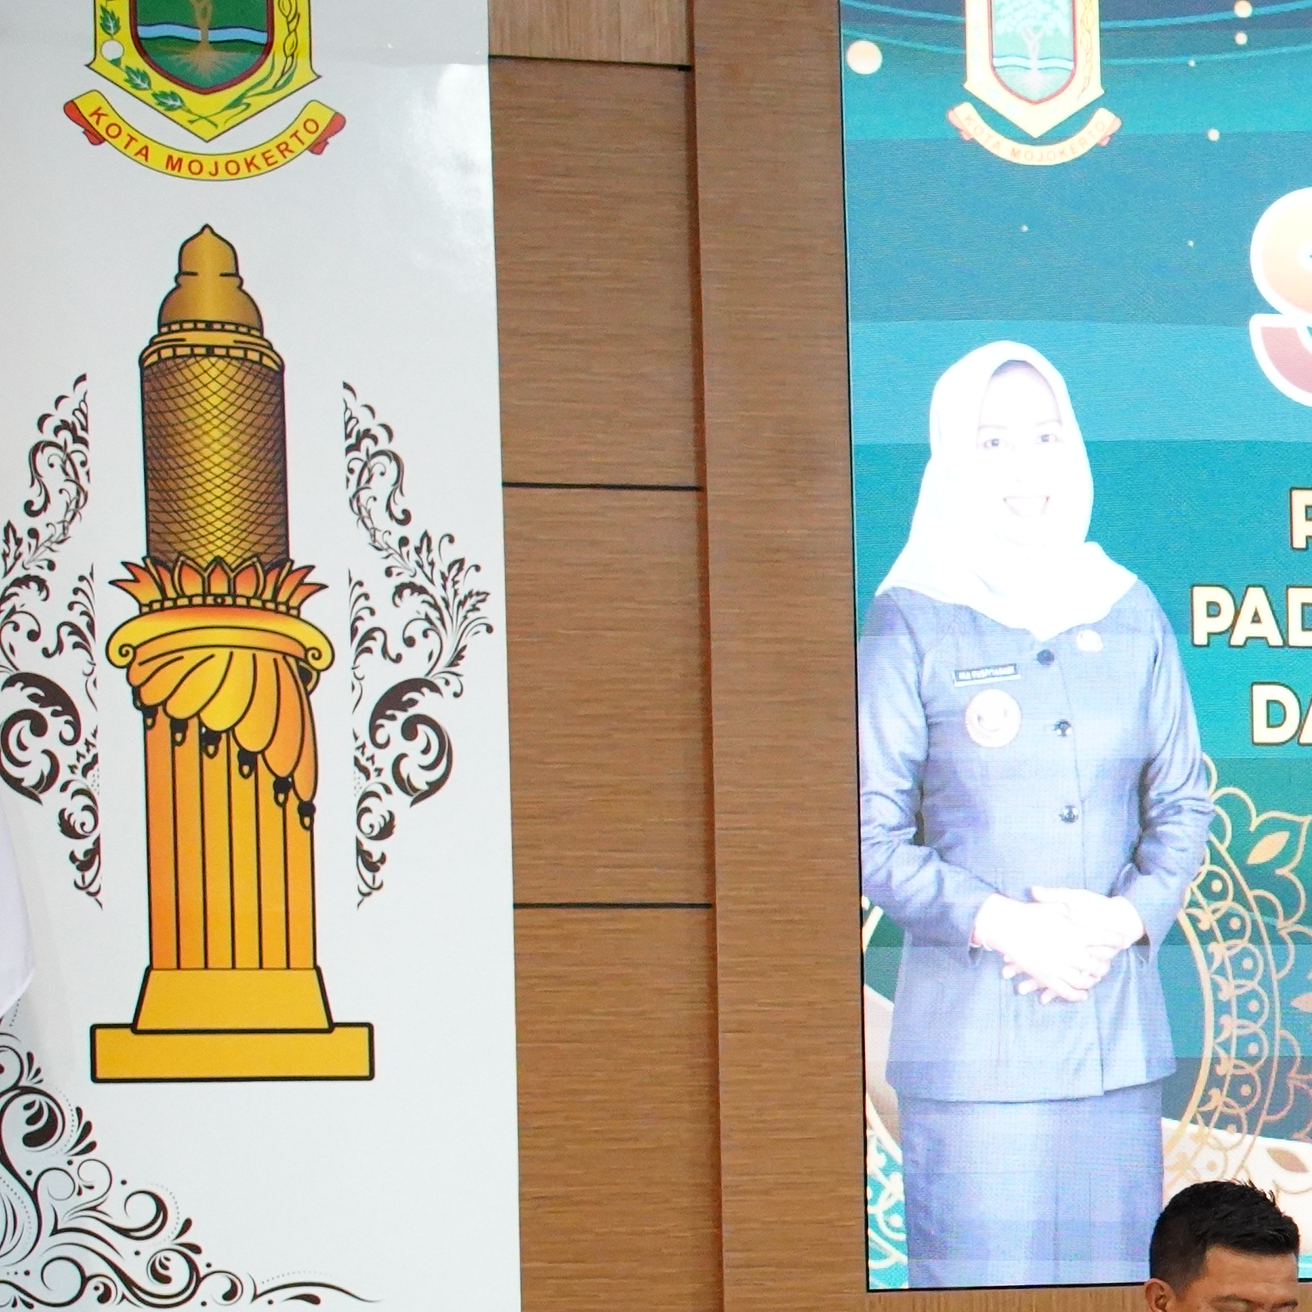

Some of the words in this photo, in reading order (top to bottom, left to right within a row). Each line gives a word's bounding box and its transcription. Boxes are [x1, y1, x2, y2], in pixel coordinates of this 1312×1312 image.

[87, 104, 153, 164] KOTA
[164, 116, 321, 177] MOJOKERTO
[964, 115, 1002, 152] KOTA
[1010, 119, 1107, 164] MOJOKERTO
